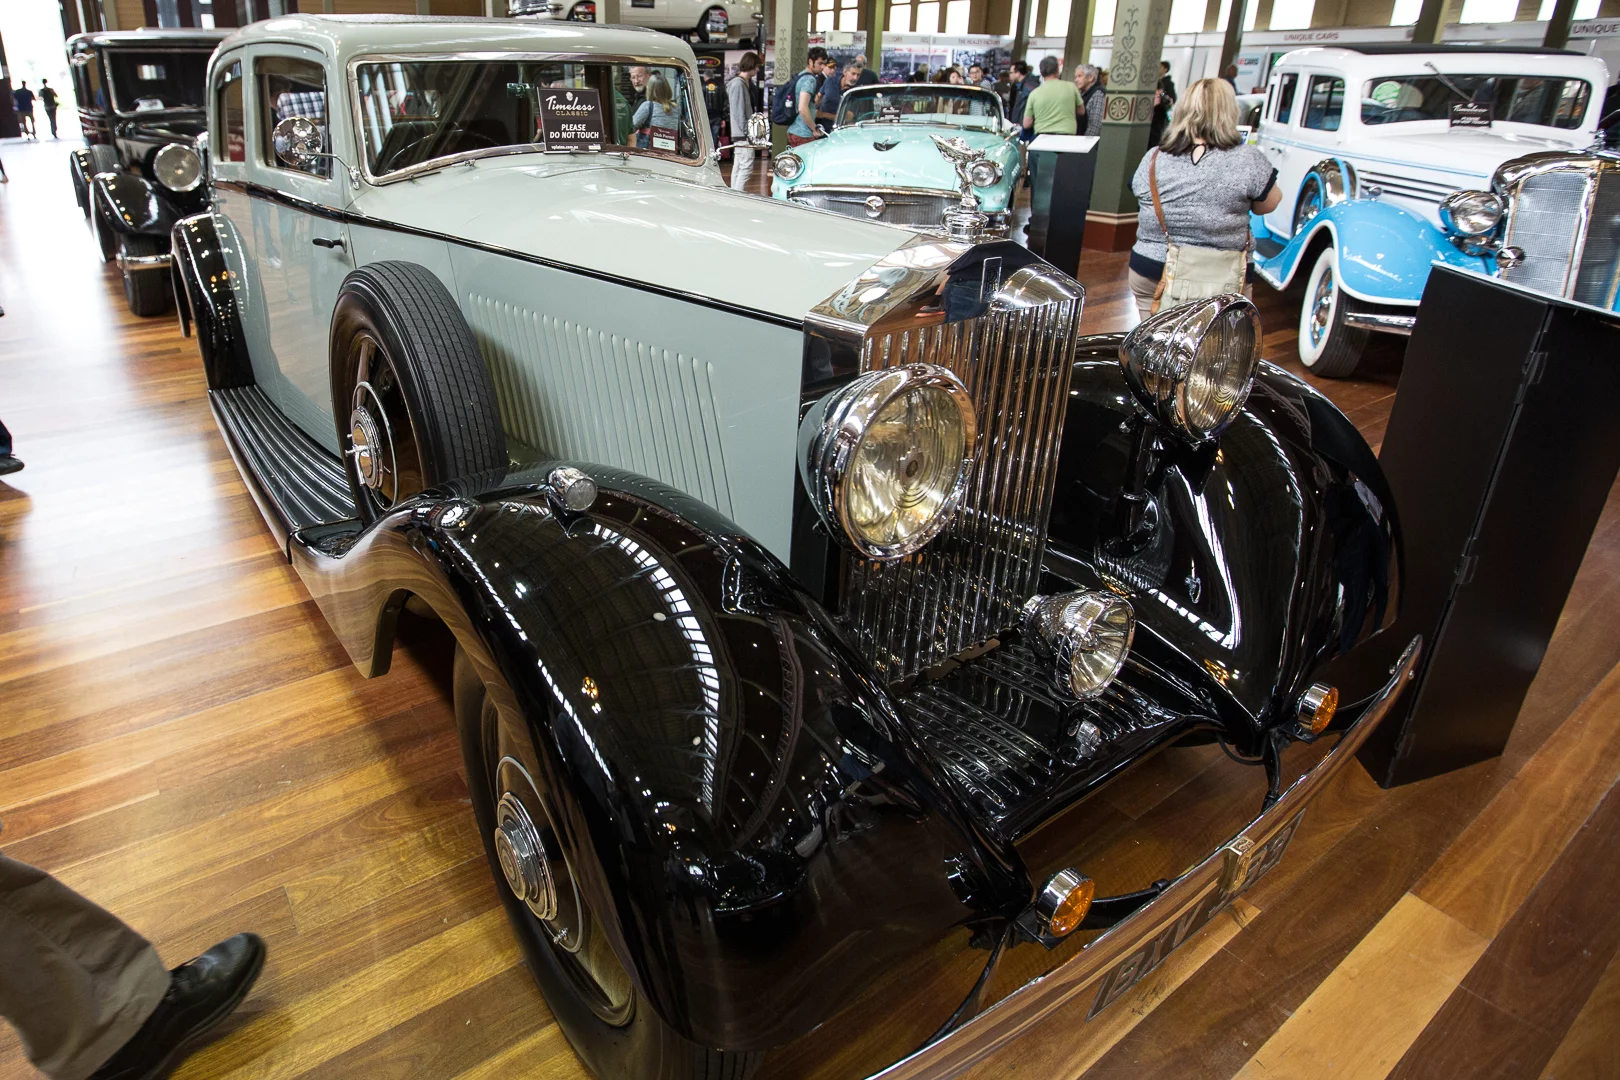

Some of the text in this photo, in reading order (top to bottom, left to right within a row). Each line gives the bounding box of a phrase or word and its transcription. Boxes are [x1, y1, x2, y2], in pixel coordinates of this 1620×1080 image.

[1572, 23, 1620, 34] UNIQUE
[1283, 31, 1339, 41] UNIQUE CARS
[545, 95, 595, 111] Timeless
[549, 131, 599, 139] DO NOT TOUCH
